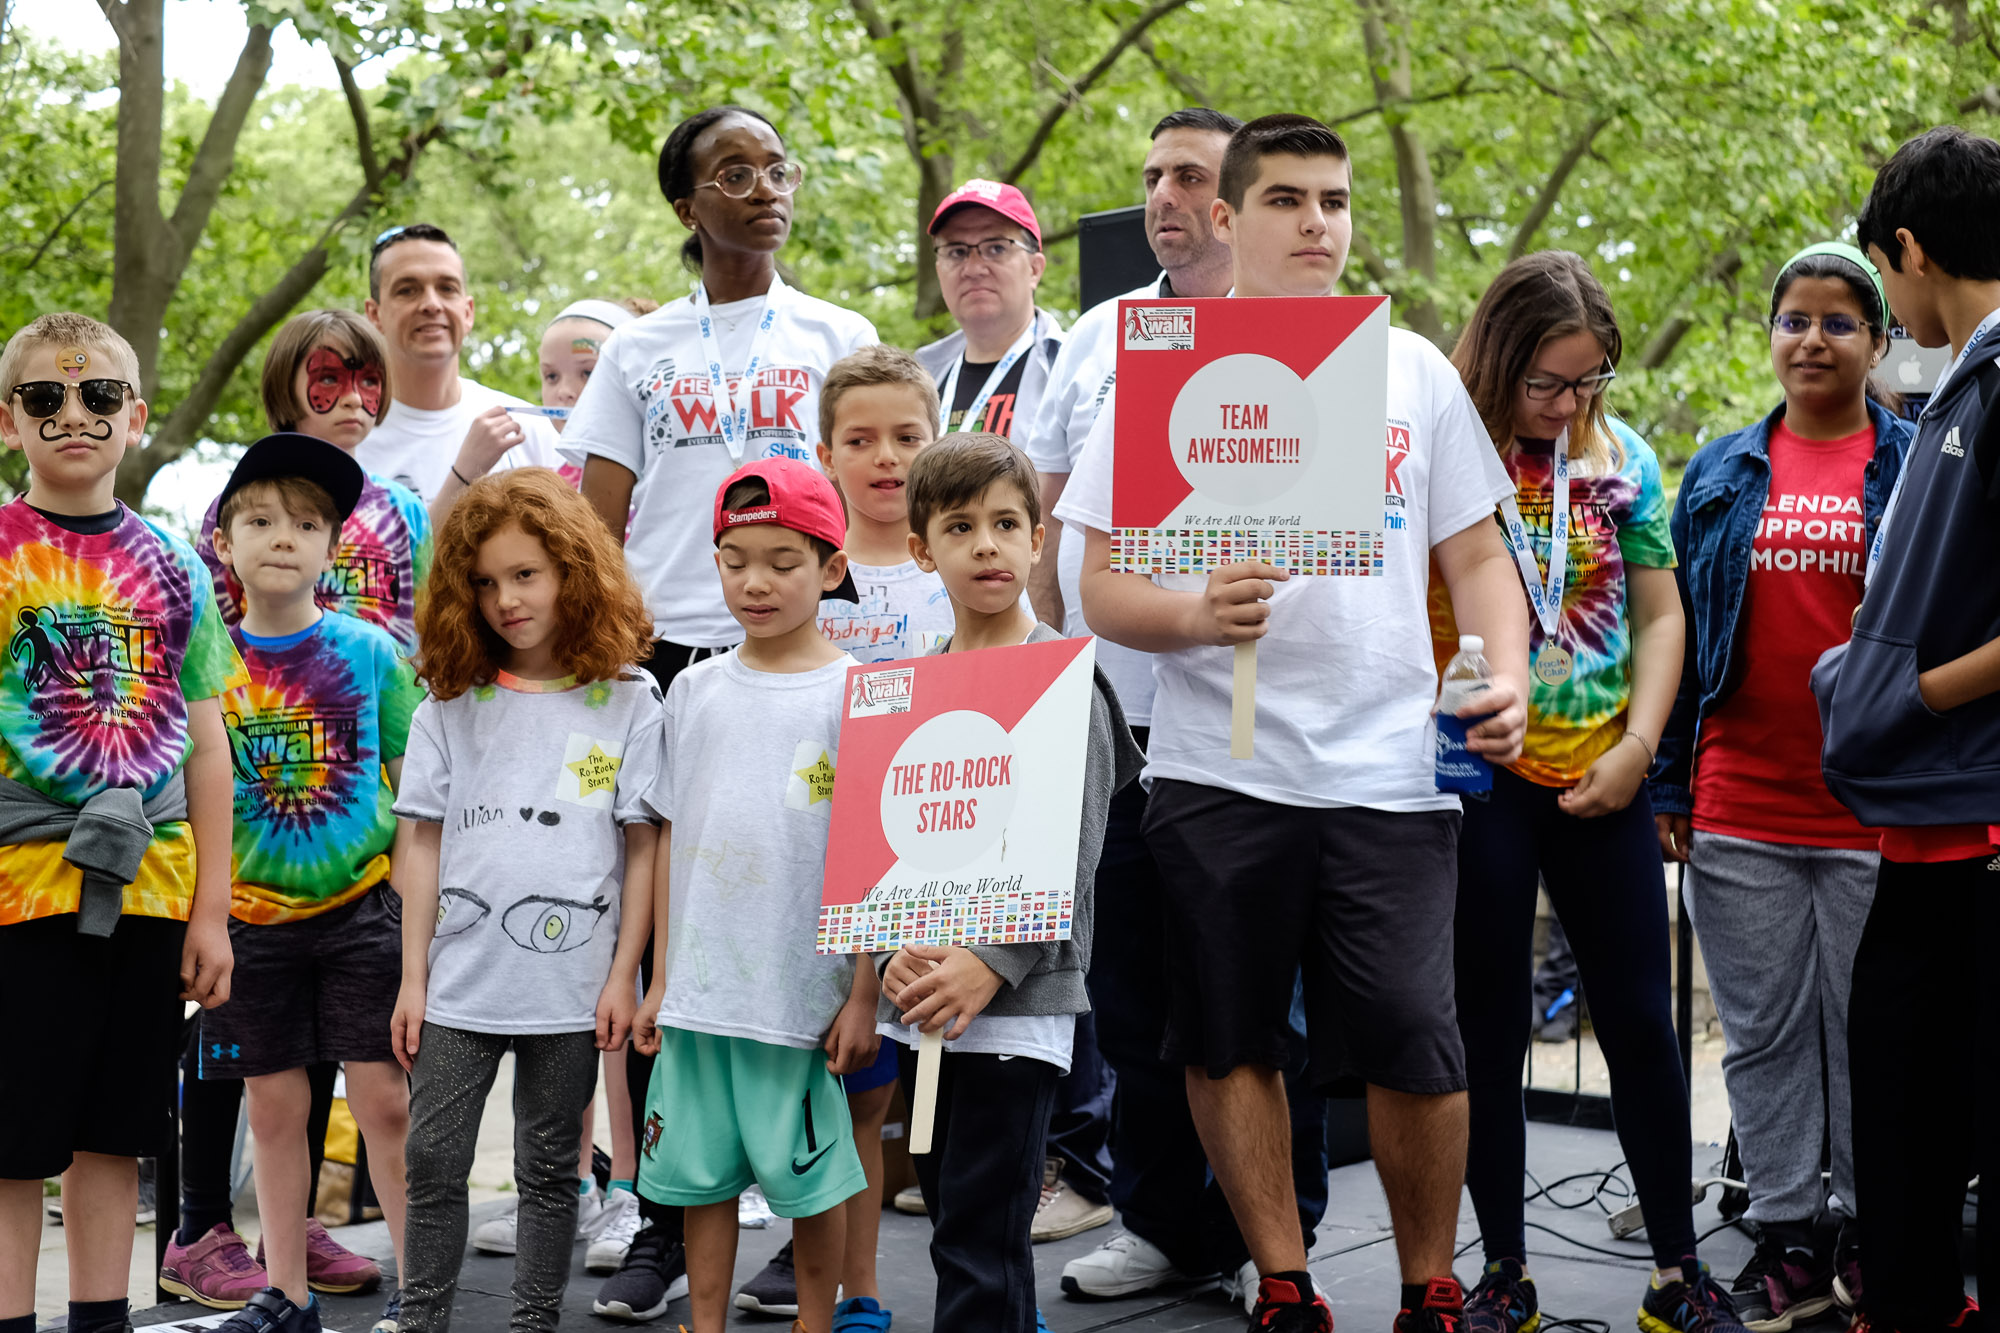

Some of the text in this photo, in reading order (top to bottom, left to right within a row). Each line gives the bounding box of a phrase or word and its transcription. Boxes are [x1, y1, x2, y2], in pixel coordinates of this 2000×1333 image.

[1149, 316, 1190, 333] walk
[680, 370, 808, 394] HEOHILIA
[671, 389, 806, 434] WLK
[1220, 404, 1268, 430] TEAM
[760, 430, 799, 438] DIFFERENC
[1187, 438, 1300, 464] AWESOME!!!!
[1941, 444, 1964, 458] idas
[1558, 452, 1567, 478] Shire
[728, 510, 777, 524] Stampeders
[1185, 515, 1301, 526] We Are All One World
[1556, 512, 1566, 539] Shire
[1510, 522, 1524, 550] Shire
[1531, 585, 1546, 615] Shire
[1549, 577, 1562, 607] Shire
[72, 628, 171, 676] walk
[1544, 668, 1567, 677] Club
[872, 678, 909, 699] walk
[120, 695, 137, 705] NYC
[140, 698, 161, 709] WALK
[110, 708, 150, 721] RIVERSIDE
[248, 721, 309, 736] HEMOPHILIA
[250, 720, 352, 765] walk
[579, 762, 615, 778] Ro-Rock
[588, 755, 603, 764] The
[588, 777, 610, 788] Stars
[892, 755, 1013, 795] THE RO-ROCK
[298, 785, 316, 793] NYC
[916, 799, 978, 834] STARS
[861, 875, 1023, 902] We Are All One World
